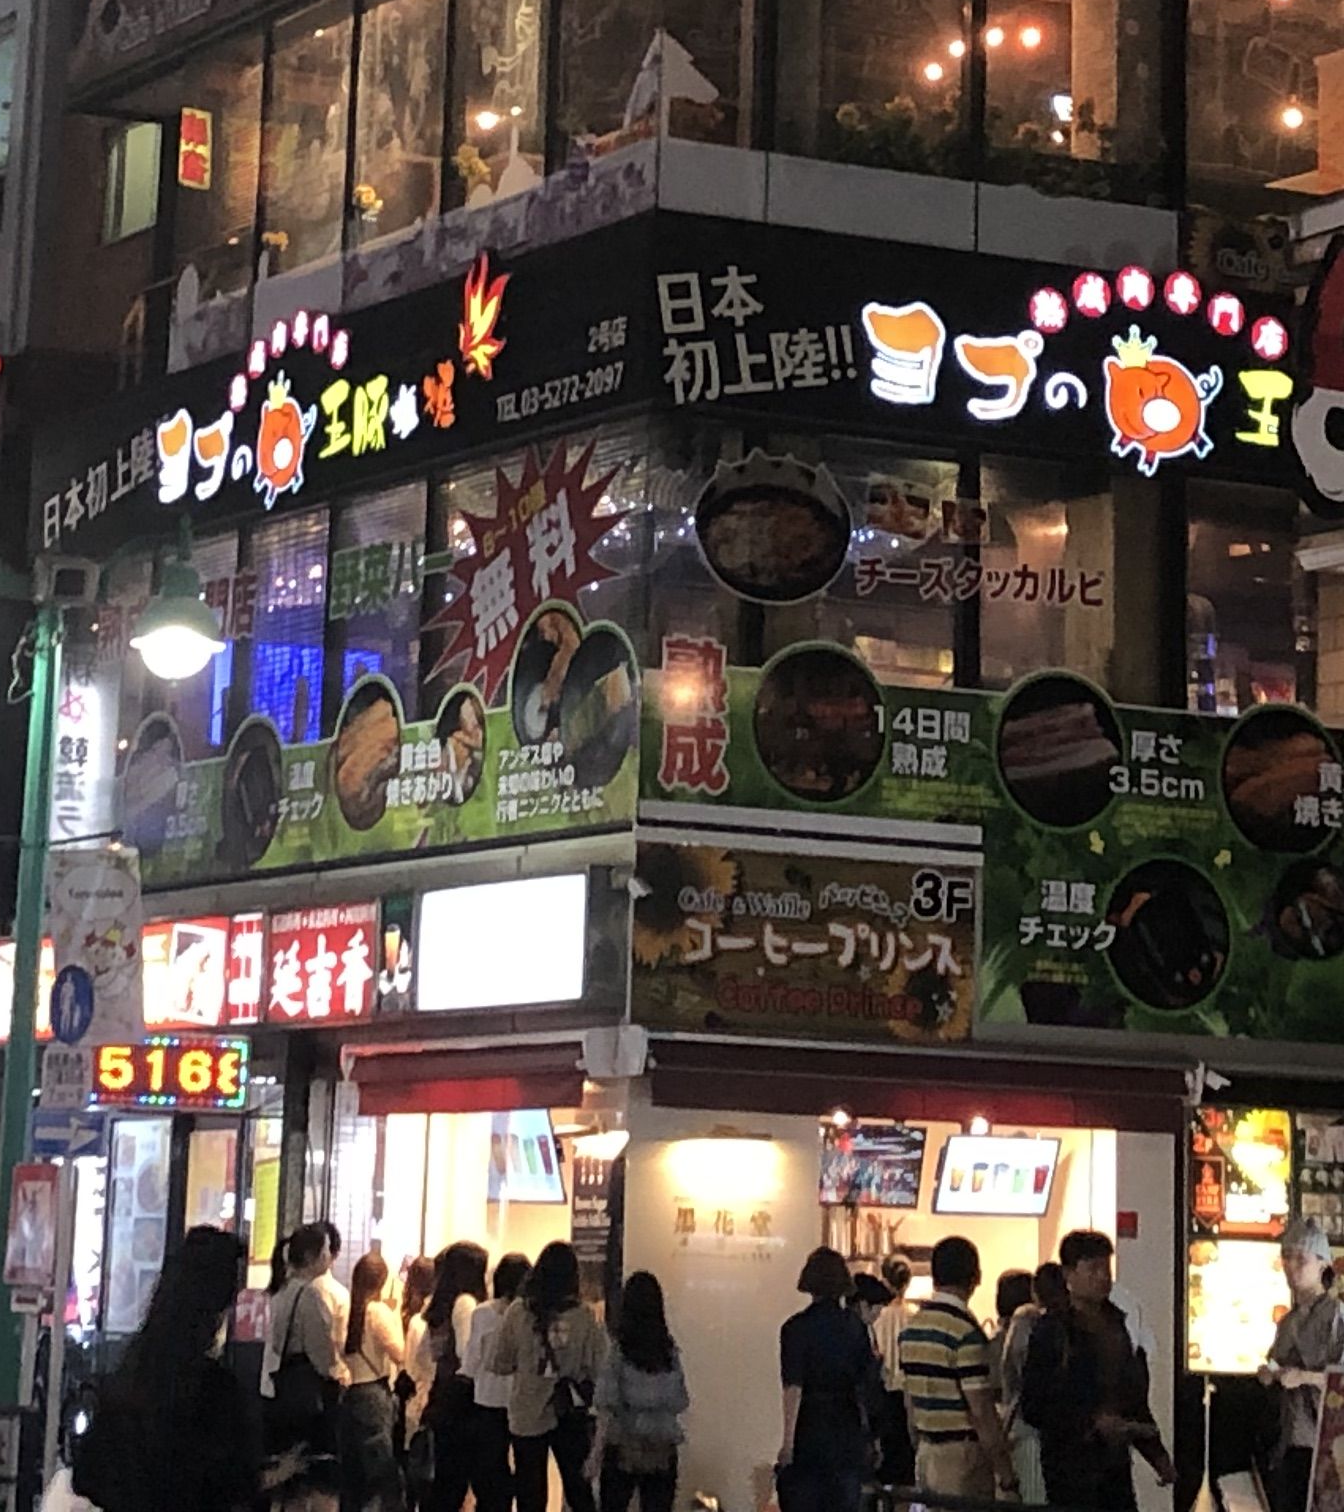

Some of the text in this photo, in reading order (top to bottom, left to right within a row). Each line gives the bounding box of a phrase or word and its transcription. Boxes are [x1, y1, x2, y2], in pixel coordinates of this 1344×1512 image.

[657, 265, 764, 335] 日本
[469, 487, 577, 661] 無料
[857, 554, 1105, 607] チーズタッカルビ
[871, 703, 972, 743] 14日間
[889, 740, 949, 778] 熟成
[1131, 728, 1185, 767] 厚さ
[1107, 763, 1206, 802] 3.5cm
[911, 868, 974, 923] 3F
[1040, 879, 1097, 917] 温度
[683, 918, 963, 976] コーヒープリンス
[1017, 914, 1119, 952] チェック
[269, 928, 373, 1019] 延吉香
